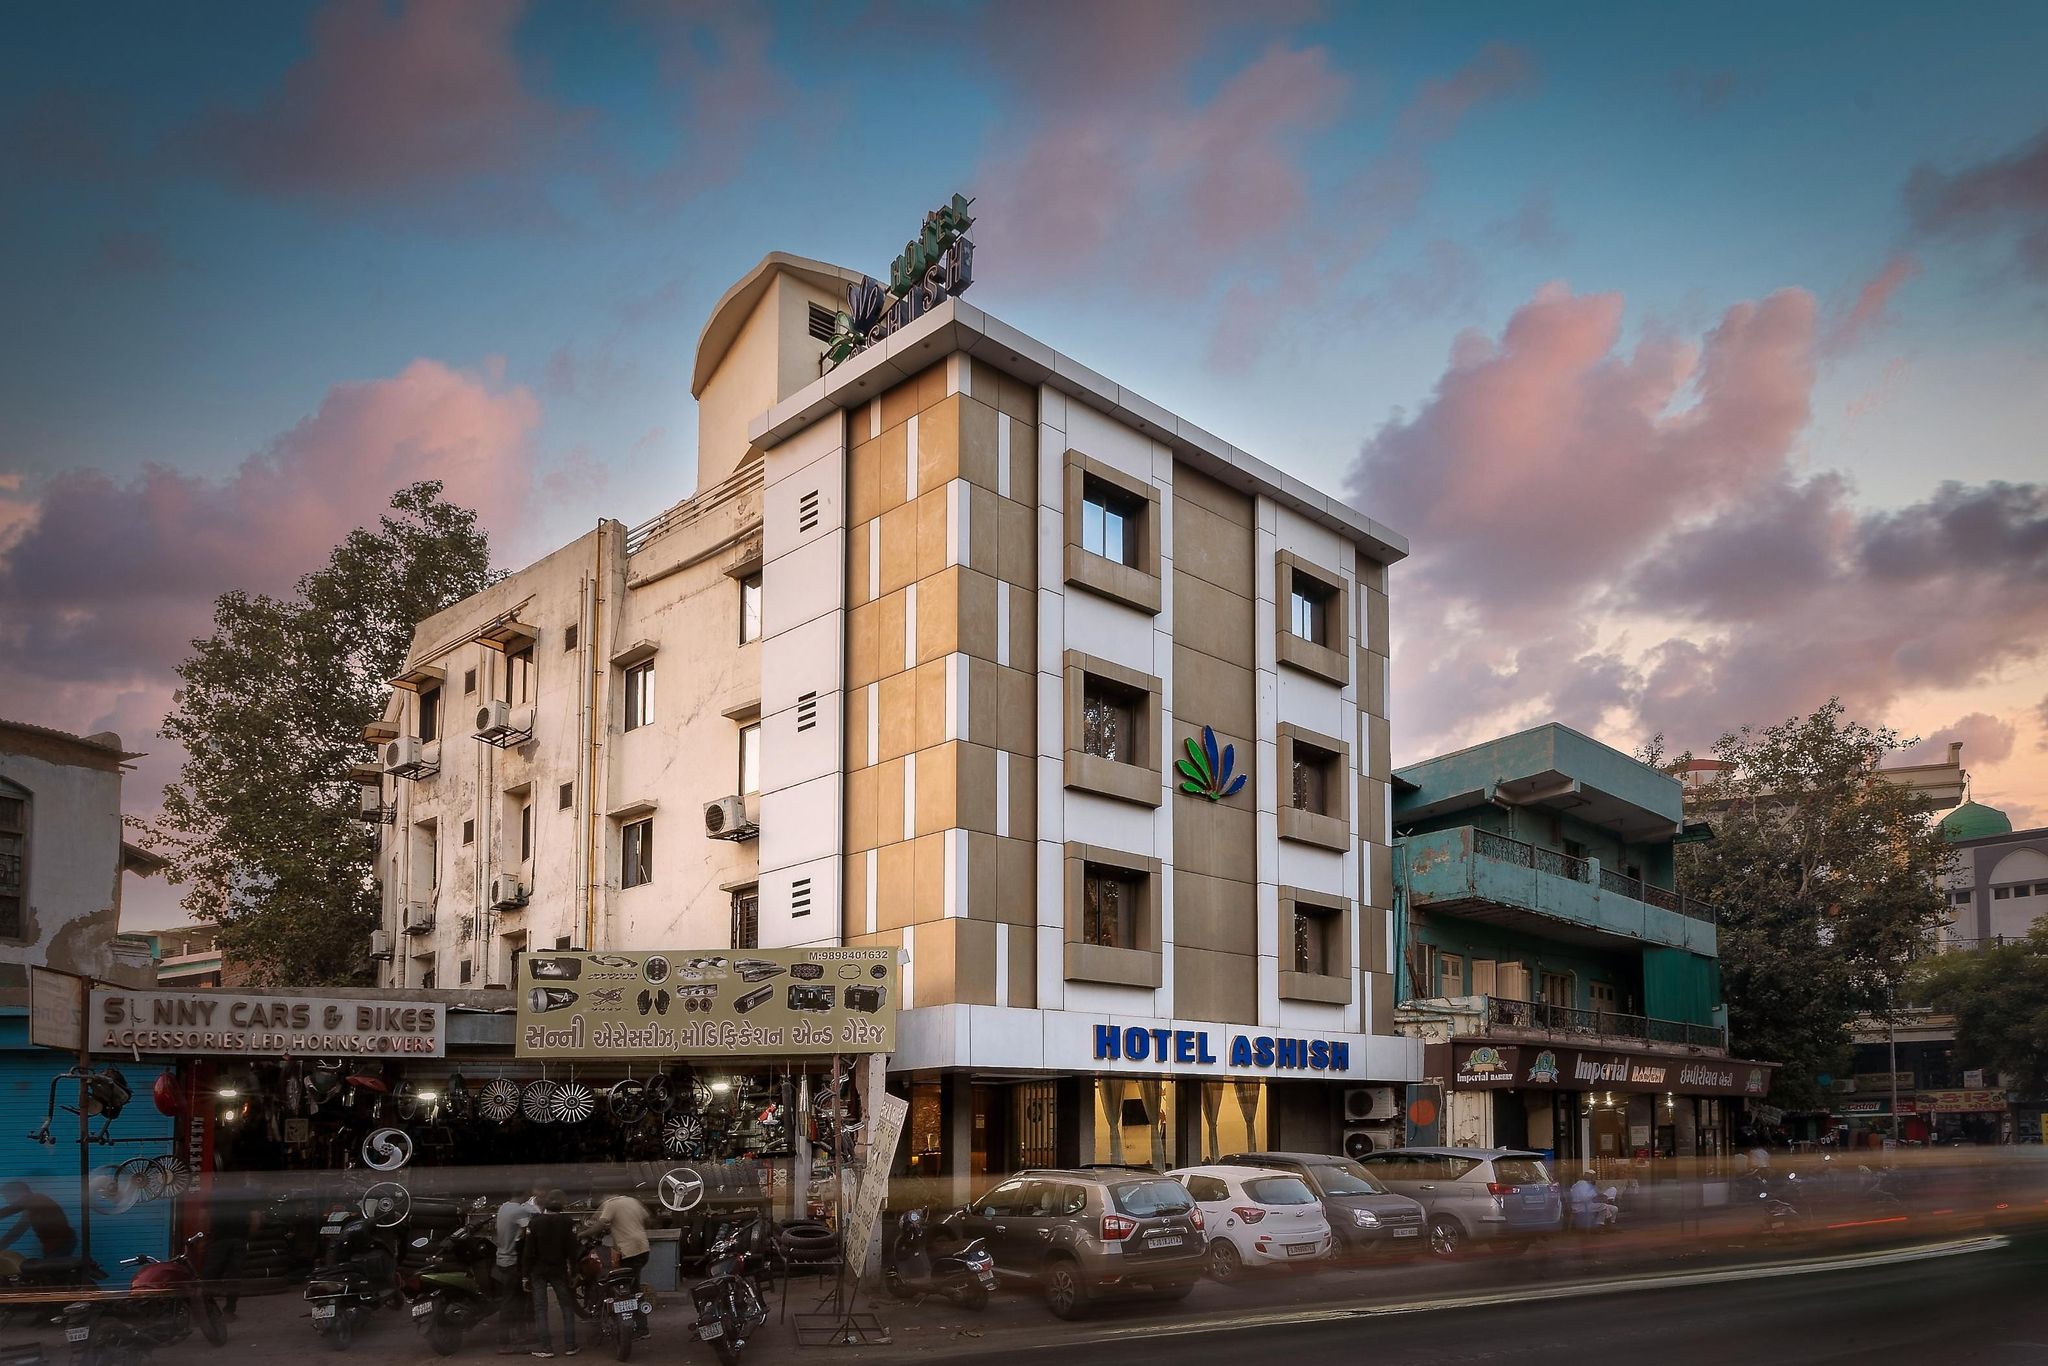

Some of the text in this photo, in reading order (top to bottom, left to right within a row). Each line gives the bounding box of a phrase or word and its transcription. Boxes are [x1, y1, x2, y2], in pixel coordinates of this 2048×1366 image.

[891, 193, 974, 299] HOTEL
[809, 950, 888, 961] M:9898401632
[103, 997, 218, 1026] SNNY
[229, 1002, 311, 1028] CARS
[323, 1006, 344, 1029] &
[356, 1006, 436, 1032] BIKES
[525, 1014, 585, 1049] સન્ની
[792, 1019, 834, 1046] એન્ડ
[841, 1018, 886, 1045] ગેરેજ
[1093, 1024, 1350, 1071] HOTEL ASHISH
[1456, 1071, 1489, 1083] Imperial
[1574, 1053, 1630, 1085] Imperial
